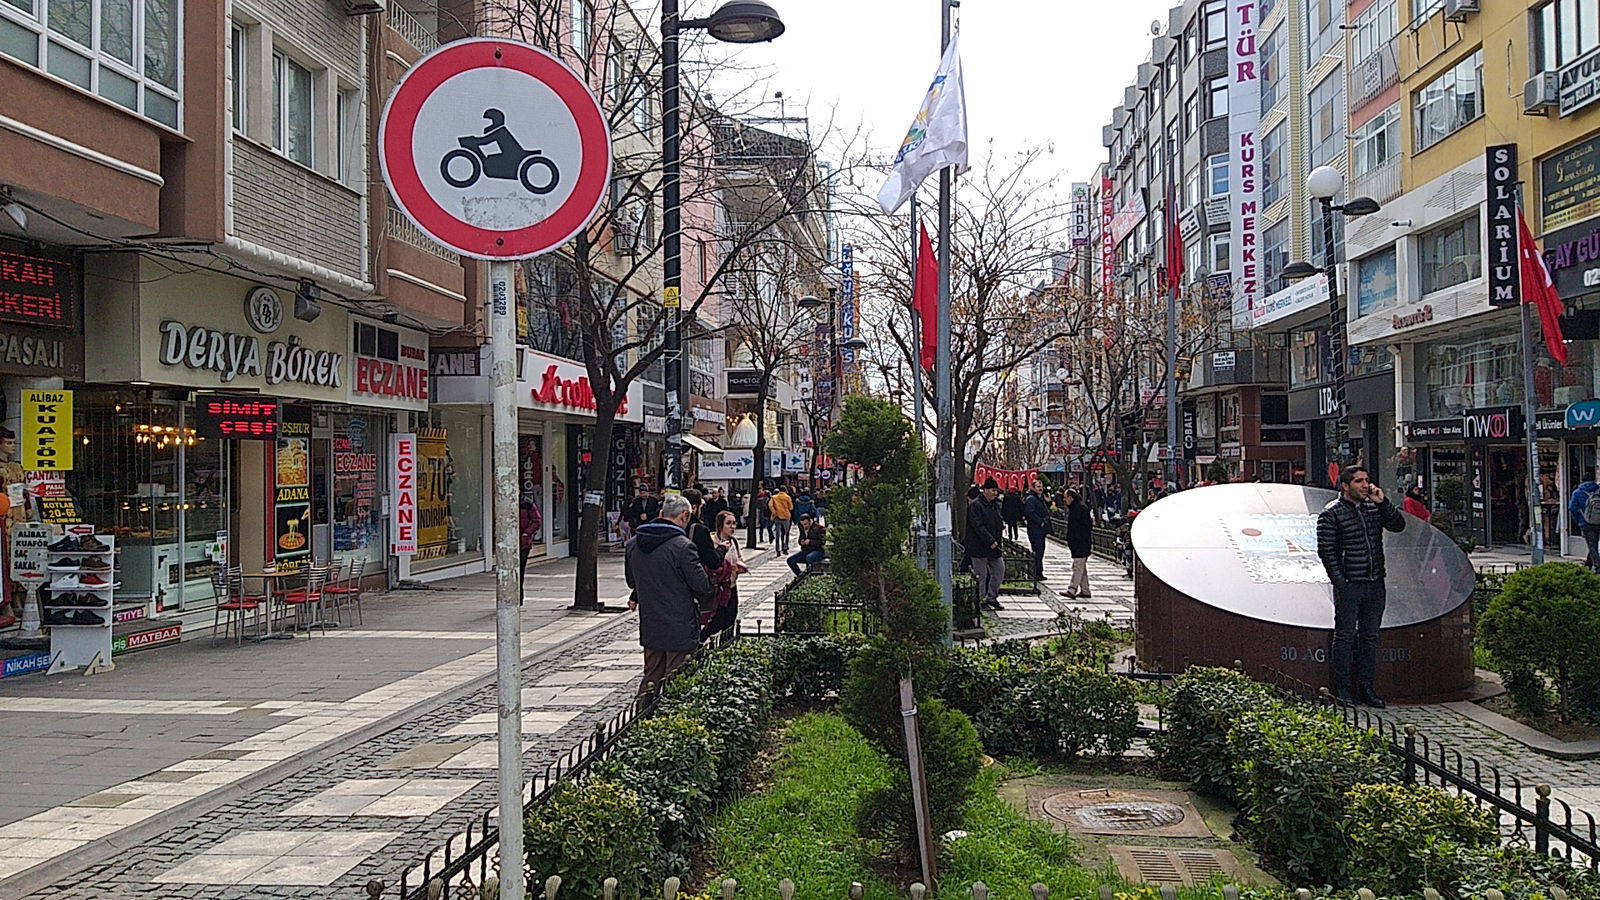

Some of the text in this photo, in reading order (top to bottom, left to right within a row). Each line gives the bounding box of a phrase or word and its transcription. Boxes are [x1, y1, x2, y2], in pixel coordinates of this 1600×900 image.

[1075, 204, 1084, 235] HDP
[1240, 132, 1257, 311] KURS MERKEZİ
[1494, 149, 1514, 300] SOLARİUM
[1577, 228, 1600, 262] GÜ
[160, 320, 343, 389] DERYA BÖREK
[356, 356, 429, 400] ECZANE
[30, 393, 64, 403] ALİBAZ
[207, 400, 277, 415] SİMİT
[36, 404, 57, 468] KUAFÖR
[282, 422, 310, 436] EŞHUR
[1183, 411, 1194, 449] COBALT
[335, 453, 377, 472] ECZANE
[26, 471, 54, 483] ÇANTA
[427, 457, 447, 501] 70
[615, 439, 626, 513] GÖZLÜ
[276, 488, 310, 501] ADANA
[397, 440, 413, 541] ECZANE
[420, 506, 448, 529] NDİRİM
[15, 538, 49, 547] KUAFÖR
[13, 549, 28, 560] SAÇ
[13, 561, 37, 570] SAKAL
[114, 607, 143, 621] ETİYE
[128, 628, 179, 646] MATBAA
[1280, 646, 1298, 661] 30
[6, 657, 36, 673] NİKAH
